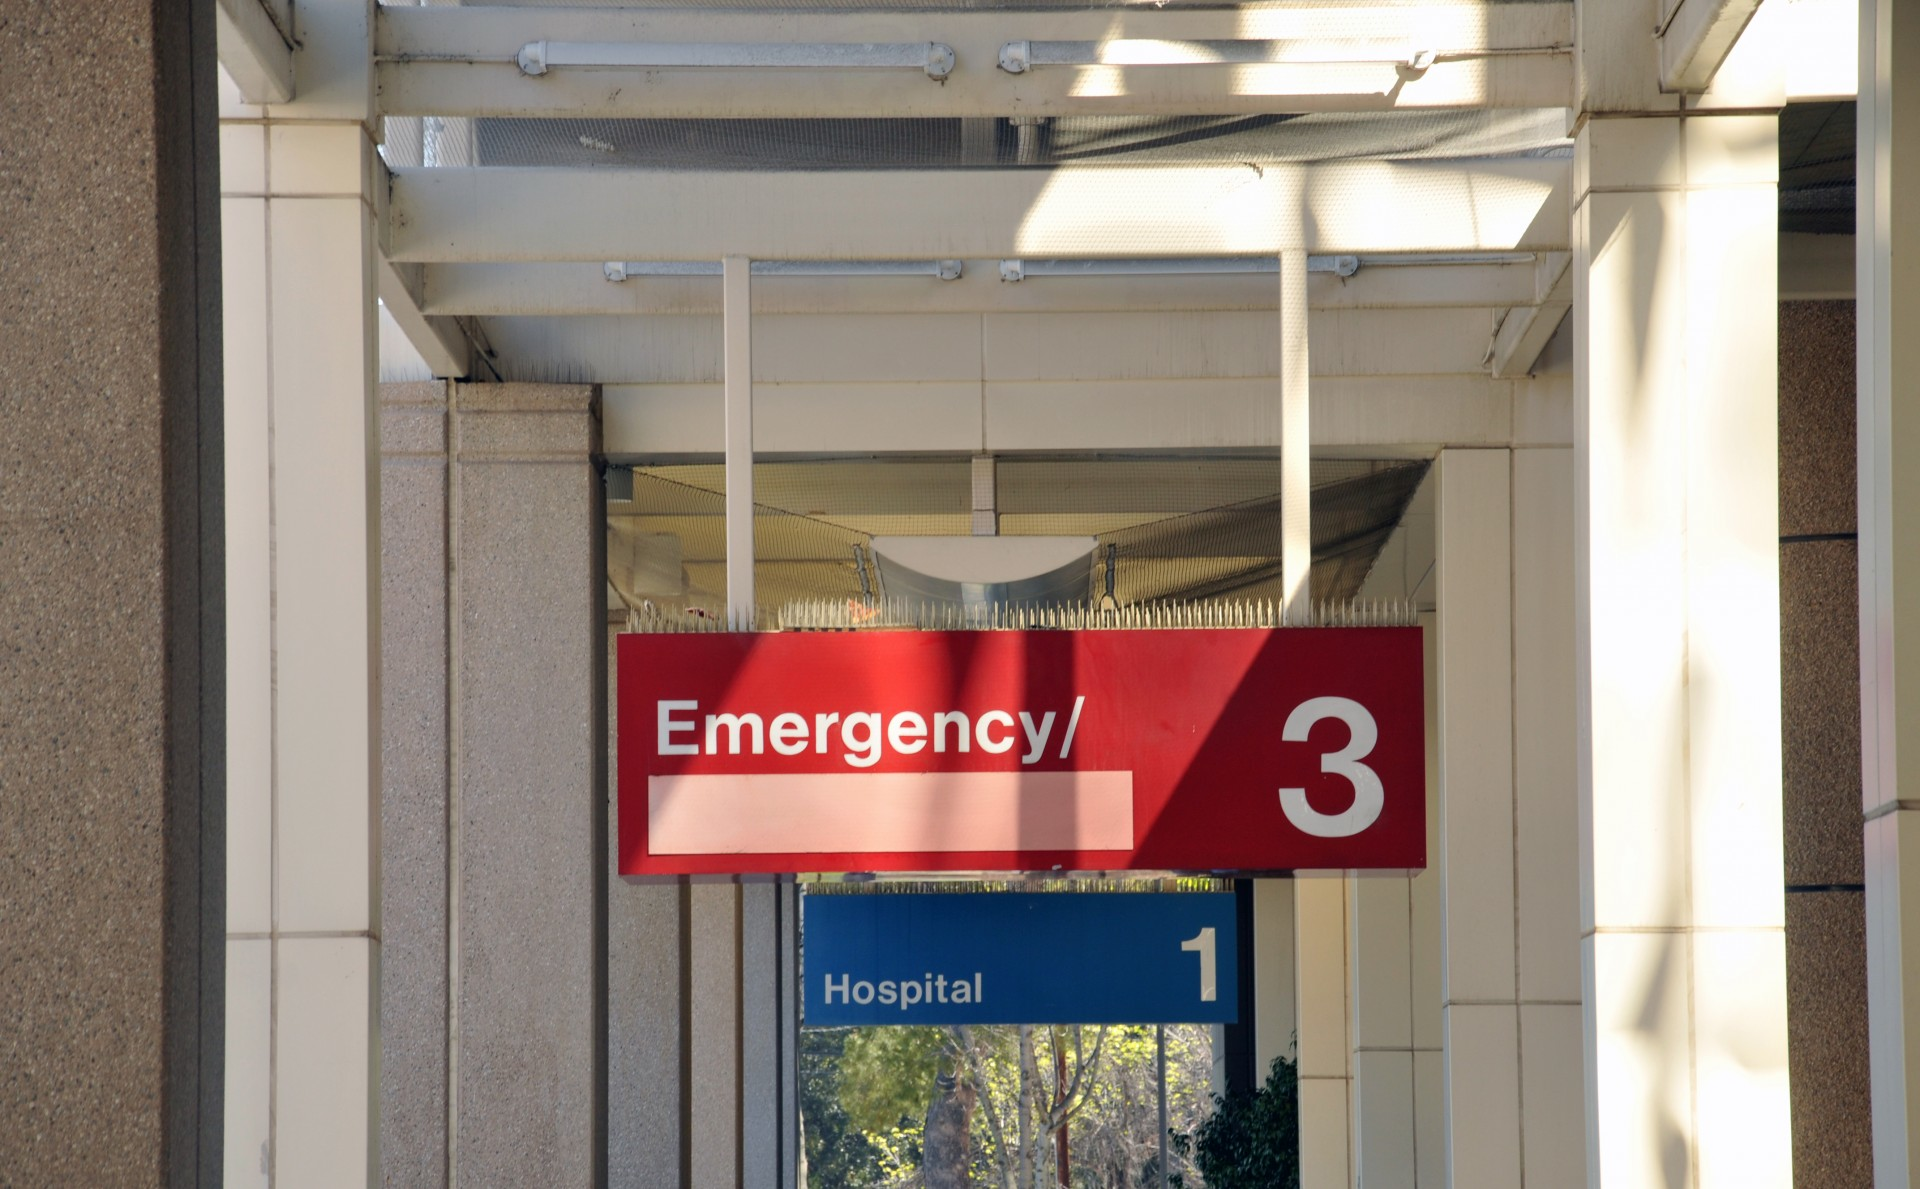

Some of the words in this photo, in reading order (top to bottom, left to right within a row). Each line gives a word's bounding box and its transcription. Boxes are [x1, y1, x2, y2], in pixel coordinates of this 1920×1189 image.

[656, 695, 1086, 768] Emergency/
[1278, 695, 1385, 839] 3
[824, 971, 983, 1011] Hospital
[1180, 926, 1217, 1003] 1
